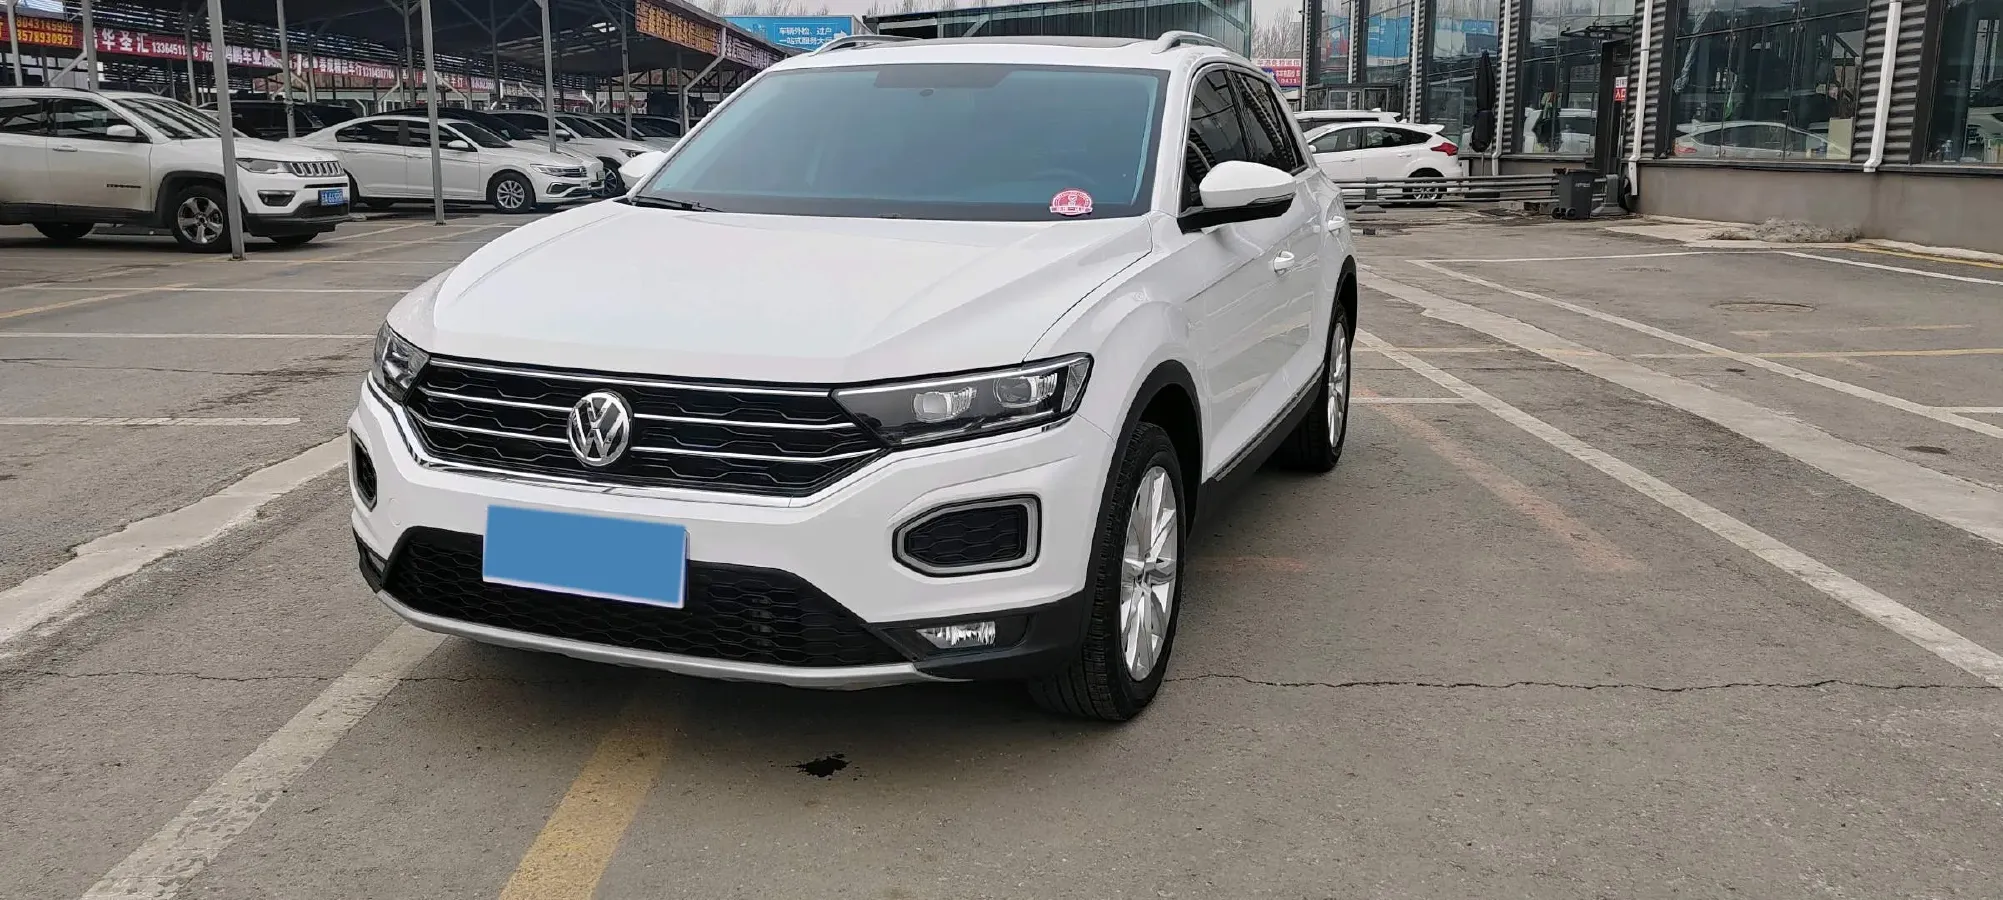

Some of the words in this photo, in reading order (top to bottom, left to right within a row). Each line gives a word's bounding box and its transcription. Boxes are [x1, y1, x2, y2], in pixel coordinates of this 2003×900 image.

[16, 16, 74, 33] 8043145999
[17, 29, 74, 46] 3578930927
[152, 41, 198, 57] 133645118
